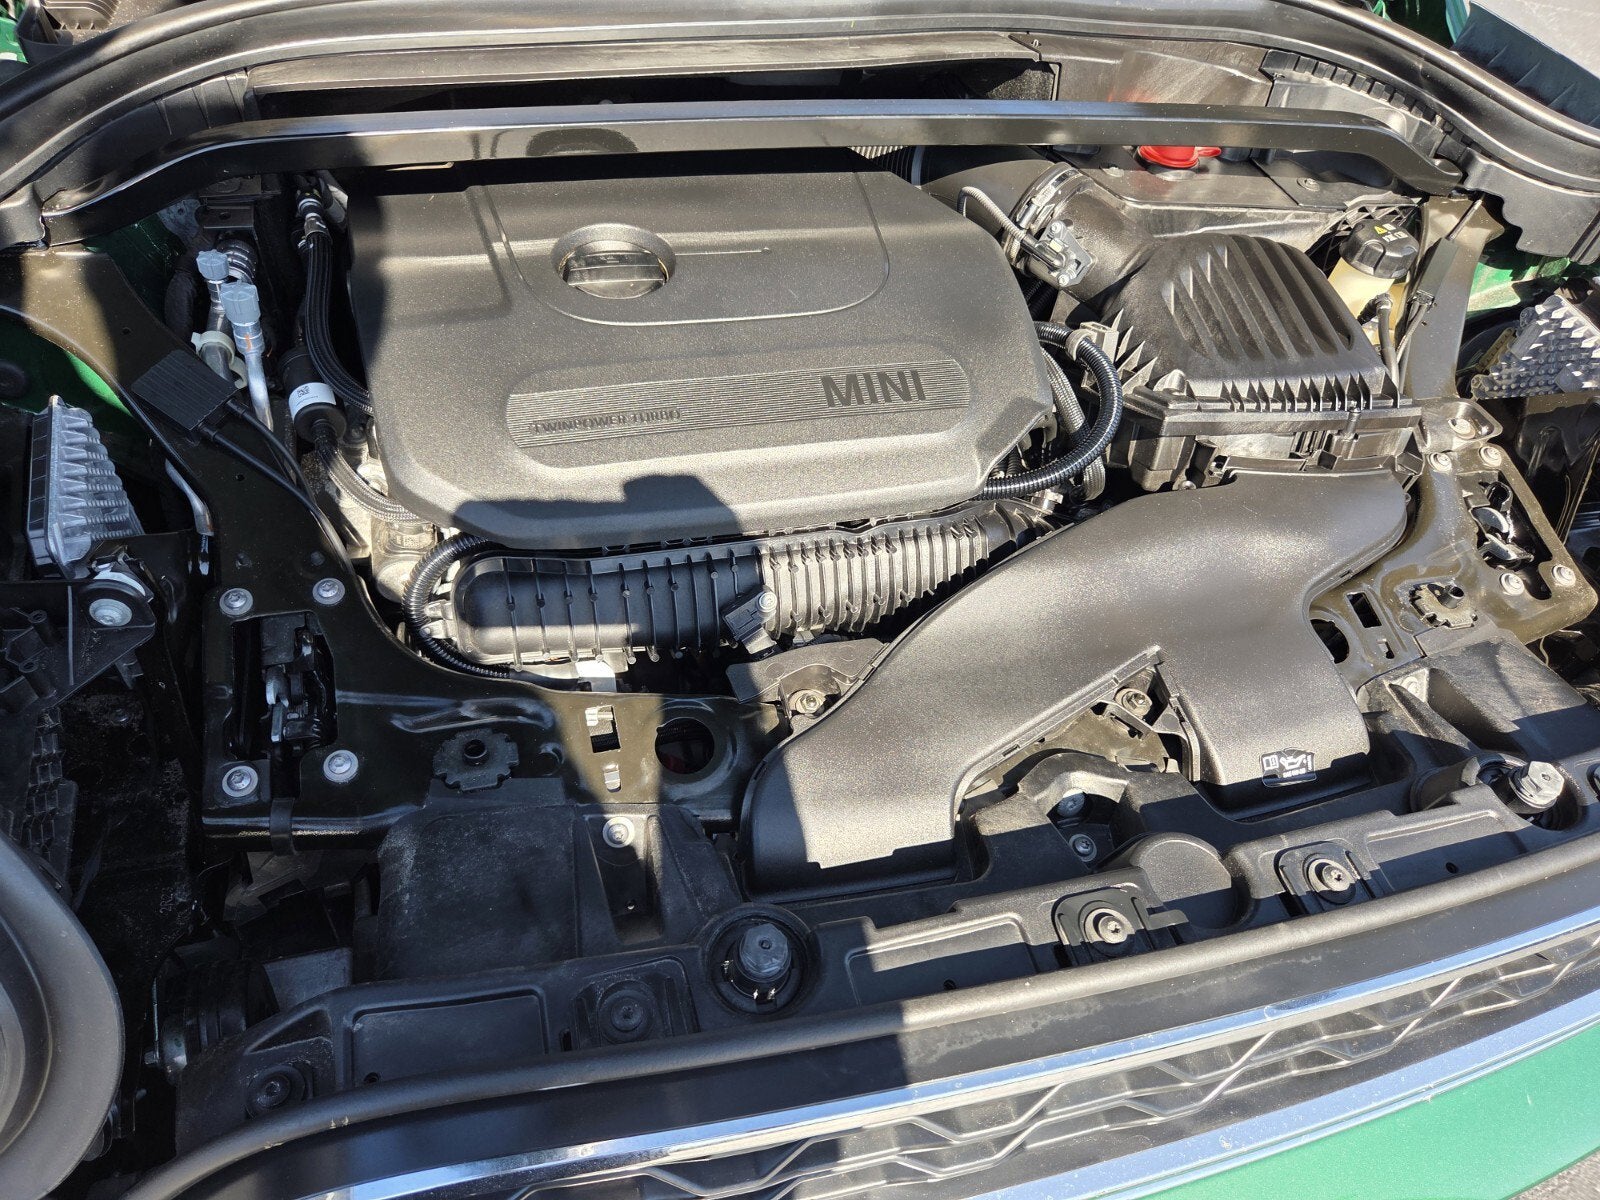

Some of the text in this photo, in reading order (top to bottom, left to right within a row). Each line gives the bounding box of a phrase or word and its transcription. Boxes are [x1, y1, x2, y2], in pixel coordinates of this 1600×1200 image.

[820, 370, 926, 407] MINI
[530, 408, 681, 434] TWINPOWER TURBO
